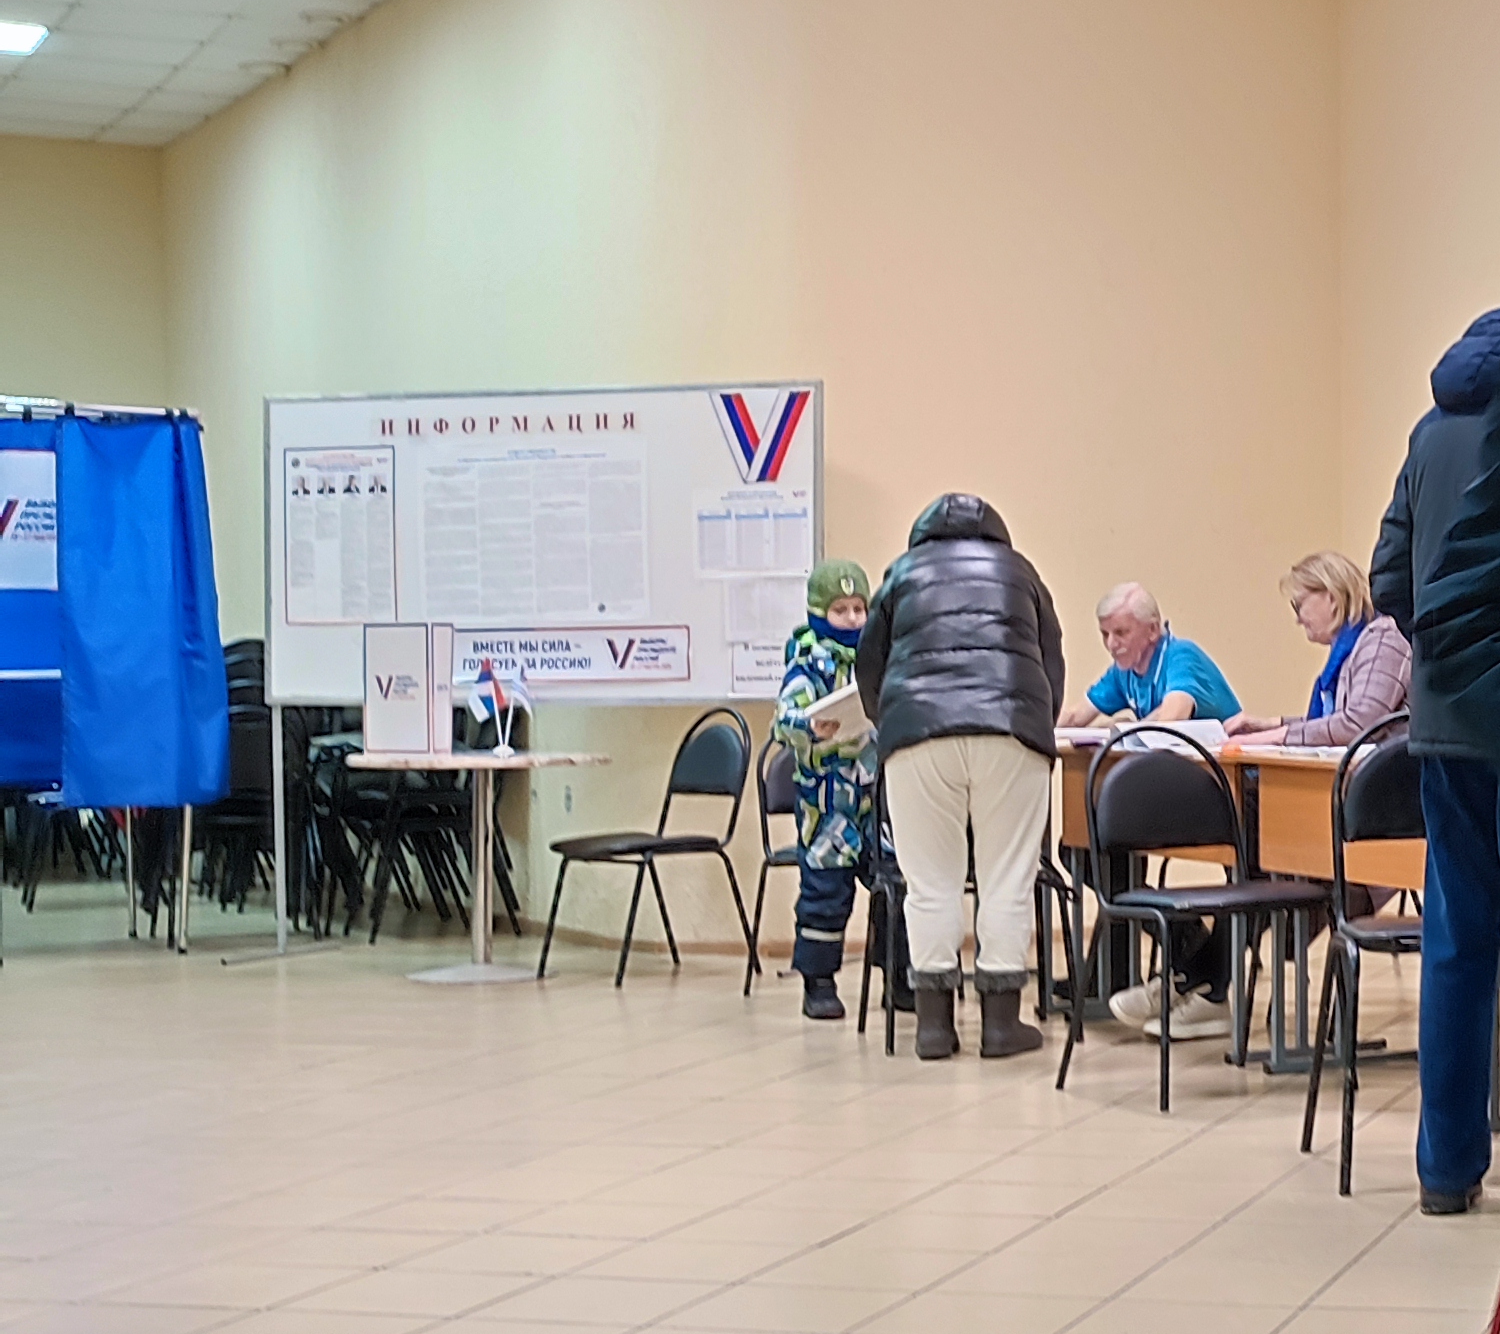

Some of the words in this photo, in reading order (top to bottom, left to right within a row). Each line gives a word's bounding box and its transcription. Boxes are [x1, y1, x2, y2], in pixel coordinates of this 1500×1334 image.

[380, 411, 636, 437] ИНФОРМАЦИЯ
[472, 639, 515, 654] ВМЕСТЕ
[518, 639, 539, 653] МЫ
[541, 639, 573, 653] СИЛА
[539, 656, 592, 670] РОССИЮ!
